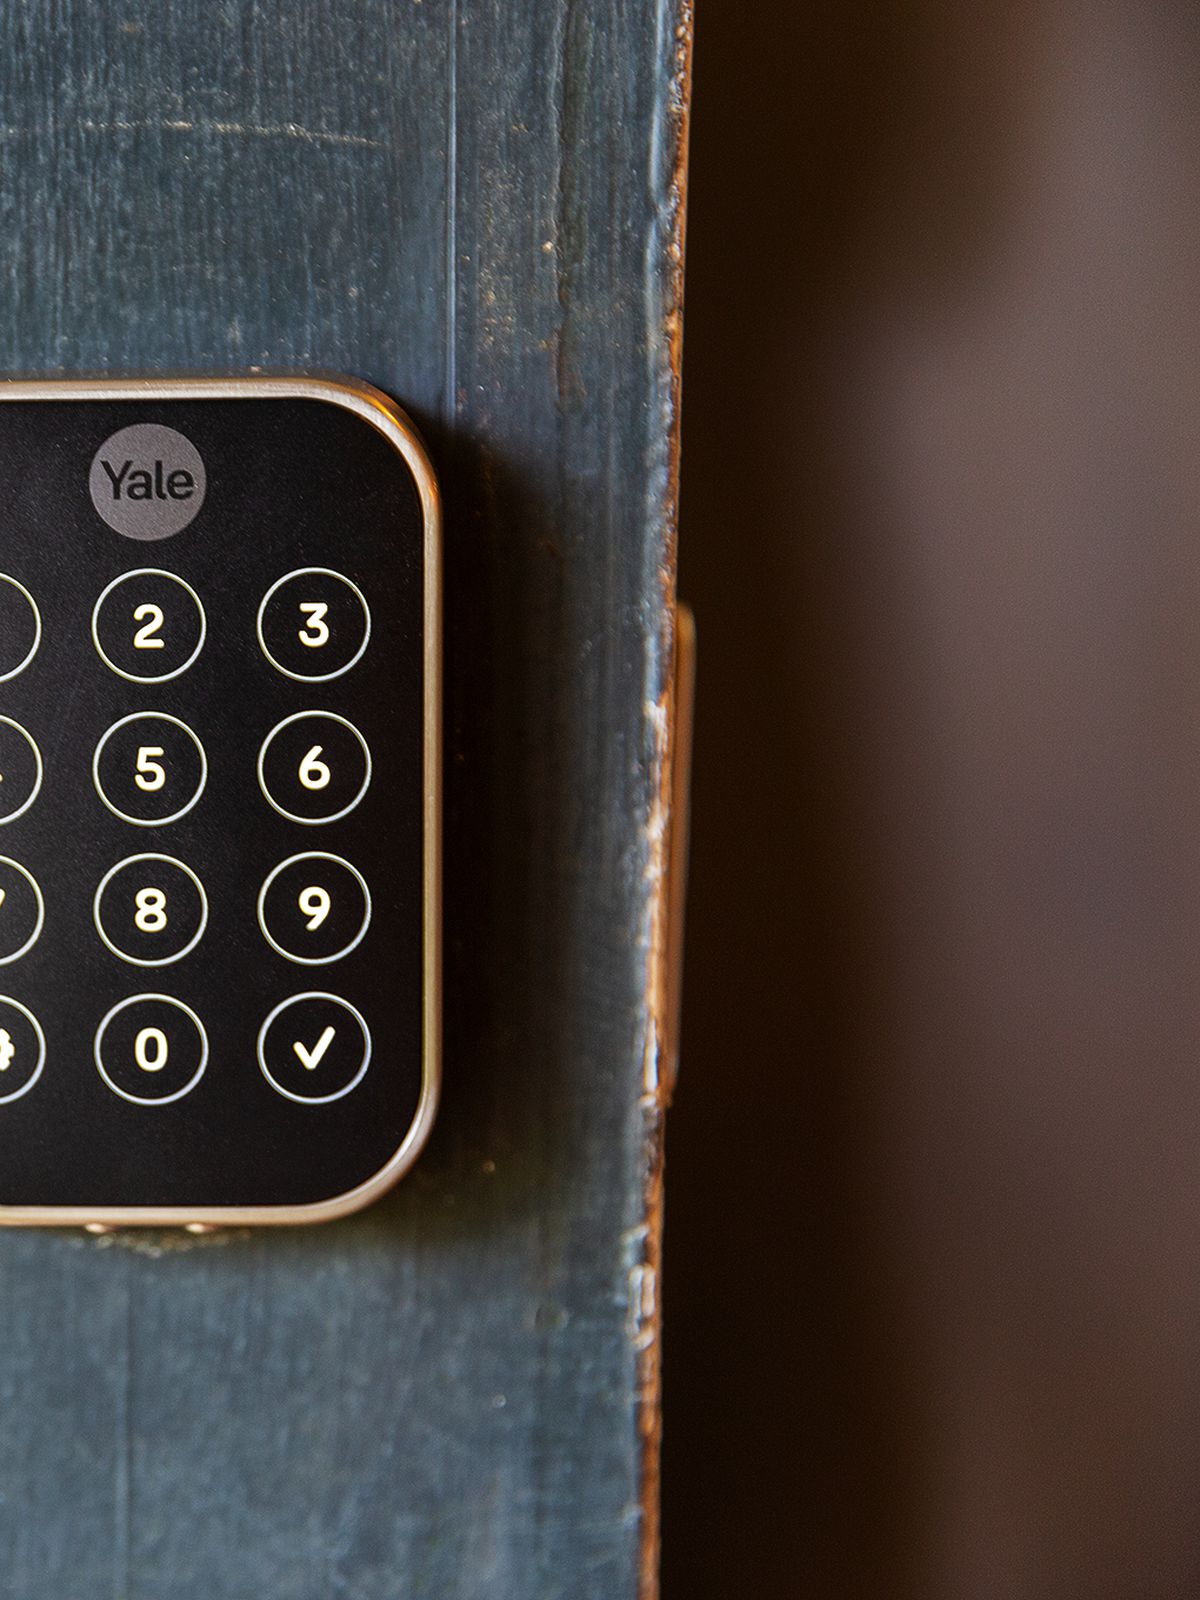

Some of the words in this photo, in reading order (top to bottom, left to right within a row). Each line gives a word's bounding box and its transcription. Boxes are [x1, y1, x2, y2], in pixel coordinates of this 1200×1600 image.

[100, 460, 194, 500] Yale
[133, 603, 165, 648] 2
[298, 602, 329, 647] 3
[134, 746, 166, 791] 5
[299, 745, 331, 789] 6
[135, 887, 167, 932] 8
[299, 886, 331, 930] 9
[135, 1027, 168, 1072] 0
